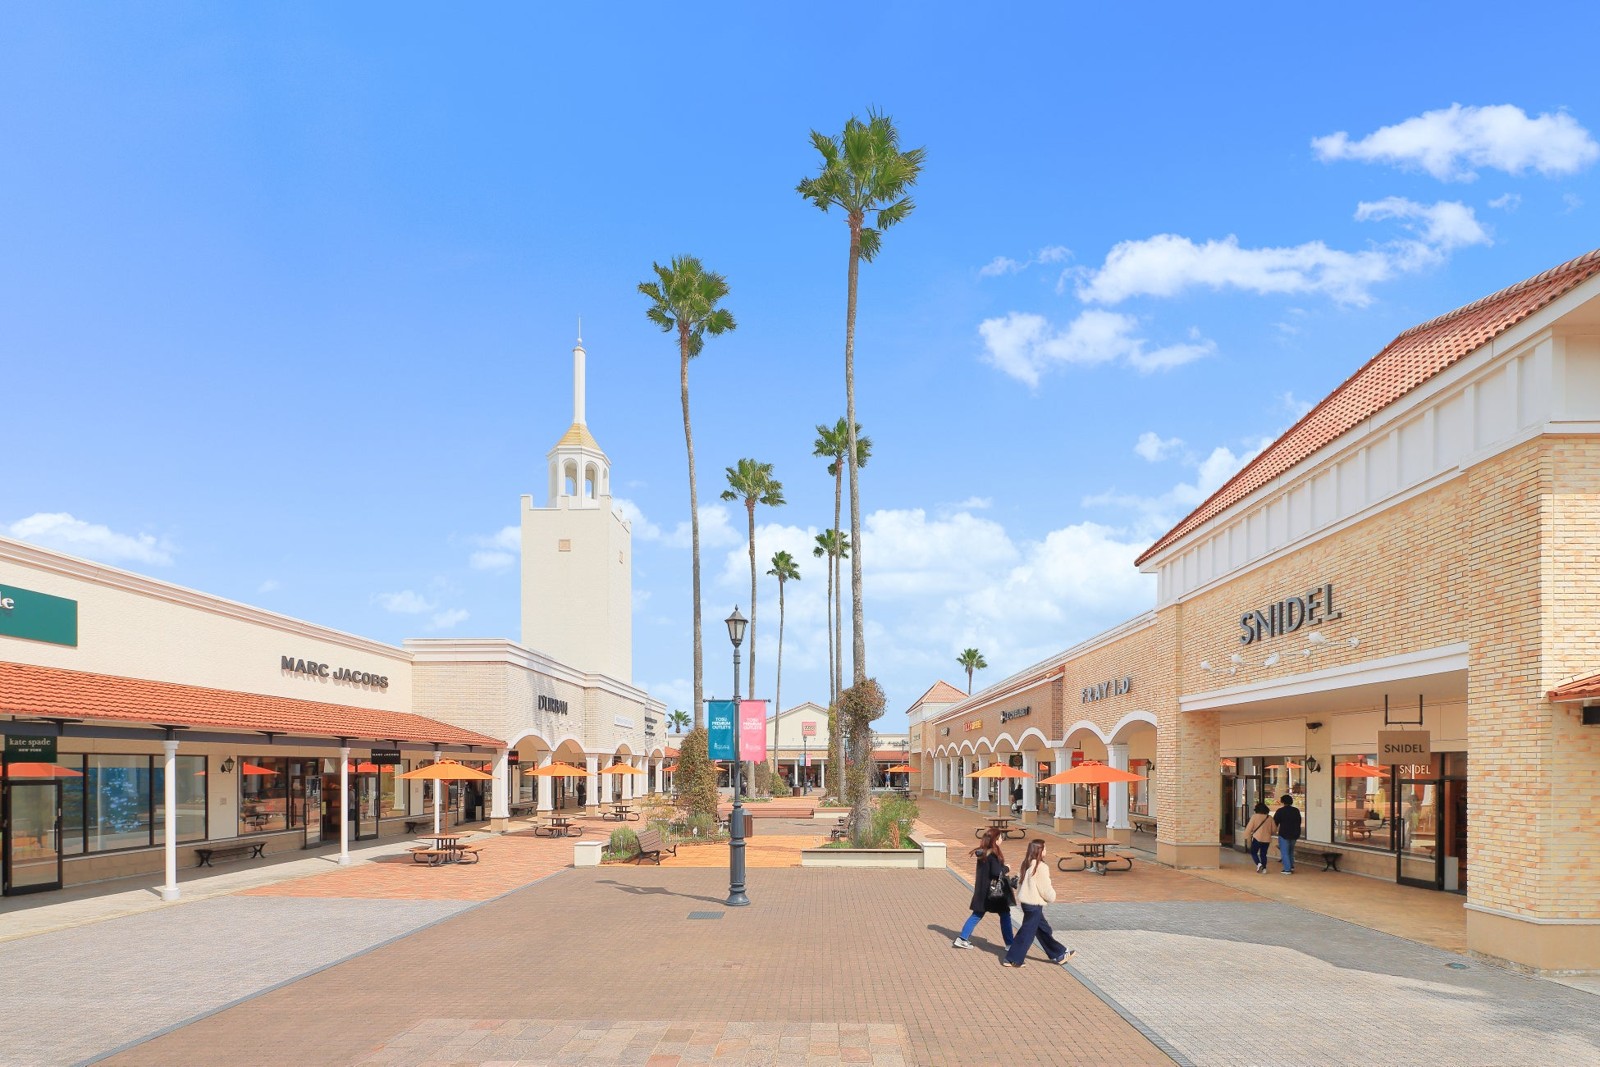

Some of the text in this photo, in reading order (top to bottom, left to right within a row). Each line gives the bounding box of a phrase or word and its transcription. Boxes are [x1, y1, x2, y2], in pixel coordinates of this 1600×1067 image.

[1239, 584, 1342, 645] SNIDEL
[281, 655, 389, 689] MARC JACOBS
[1081, 677, 1130, 704] FRAY I.D
[28, 738, 51, 748] spade
[1384, 744, 1424, 752] SNIDEL
